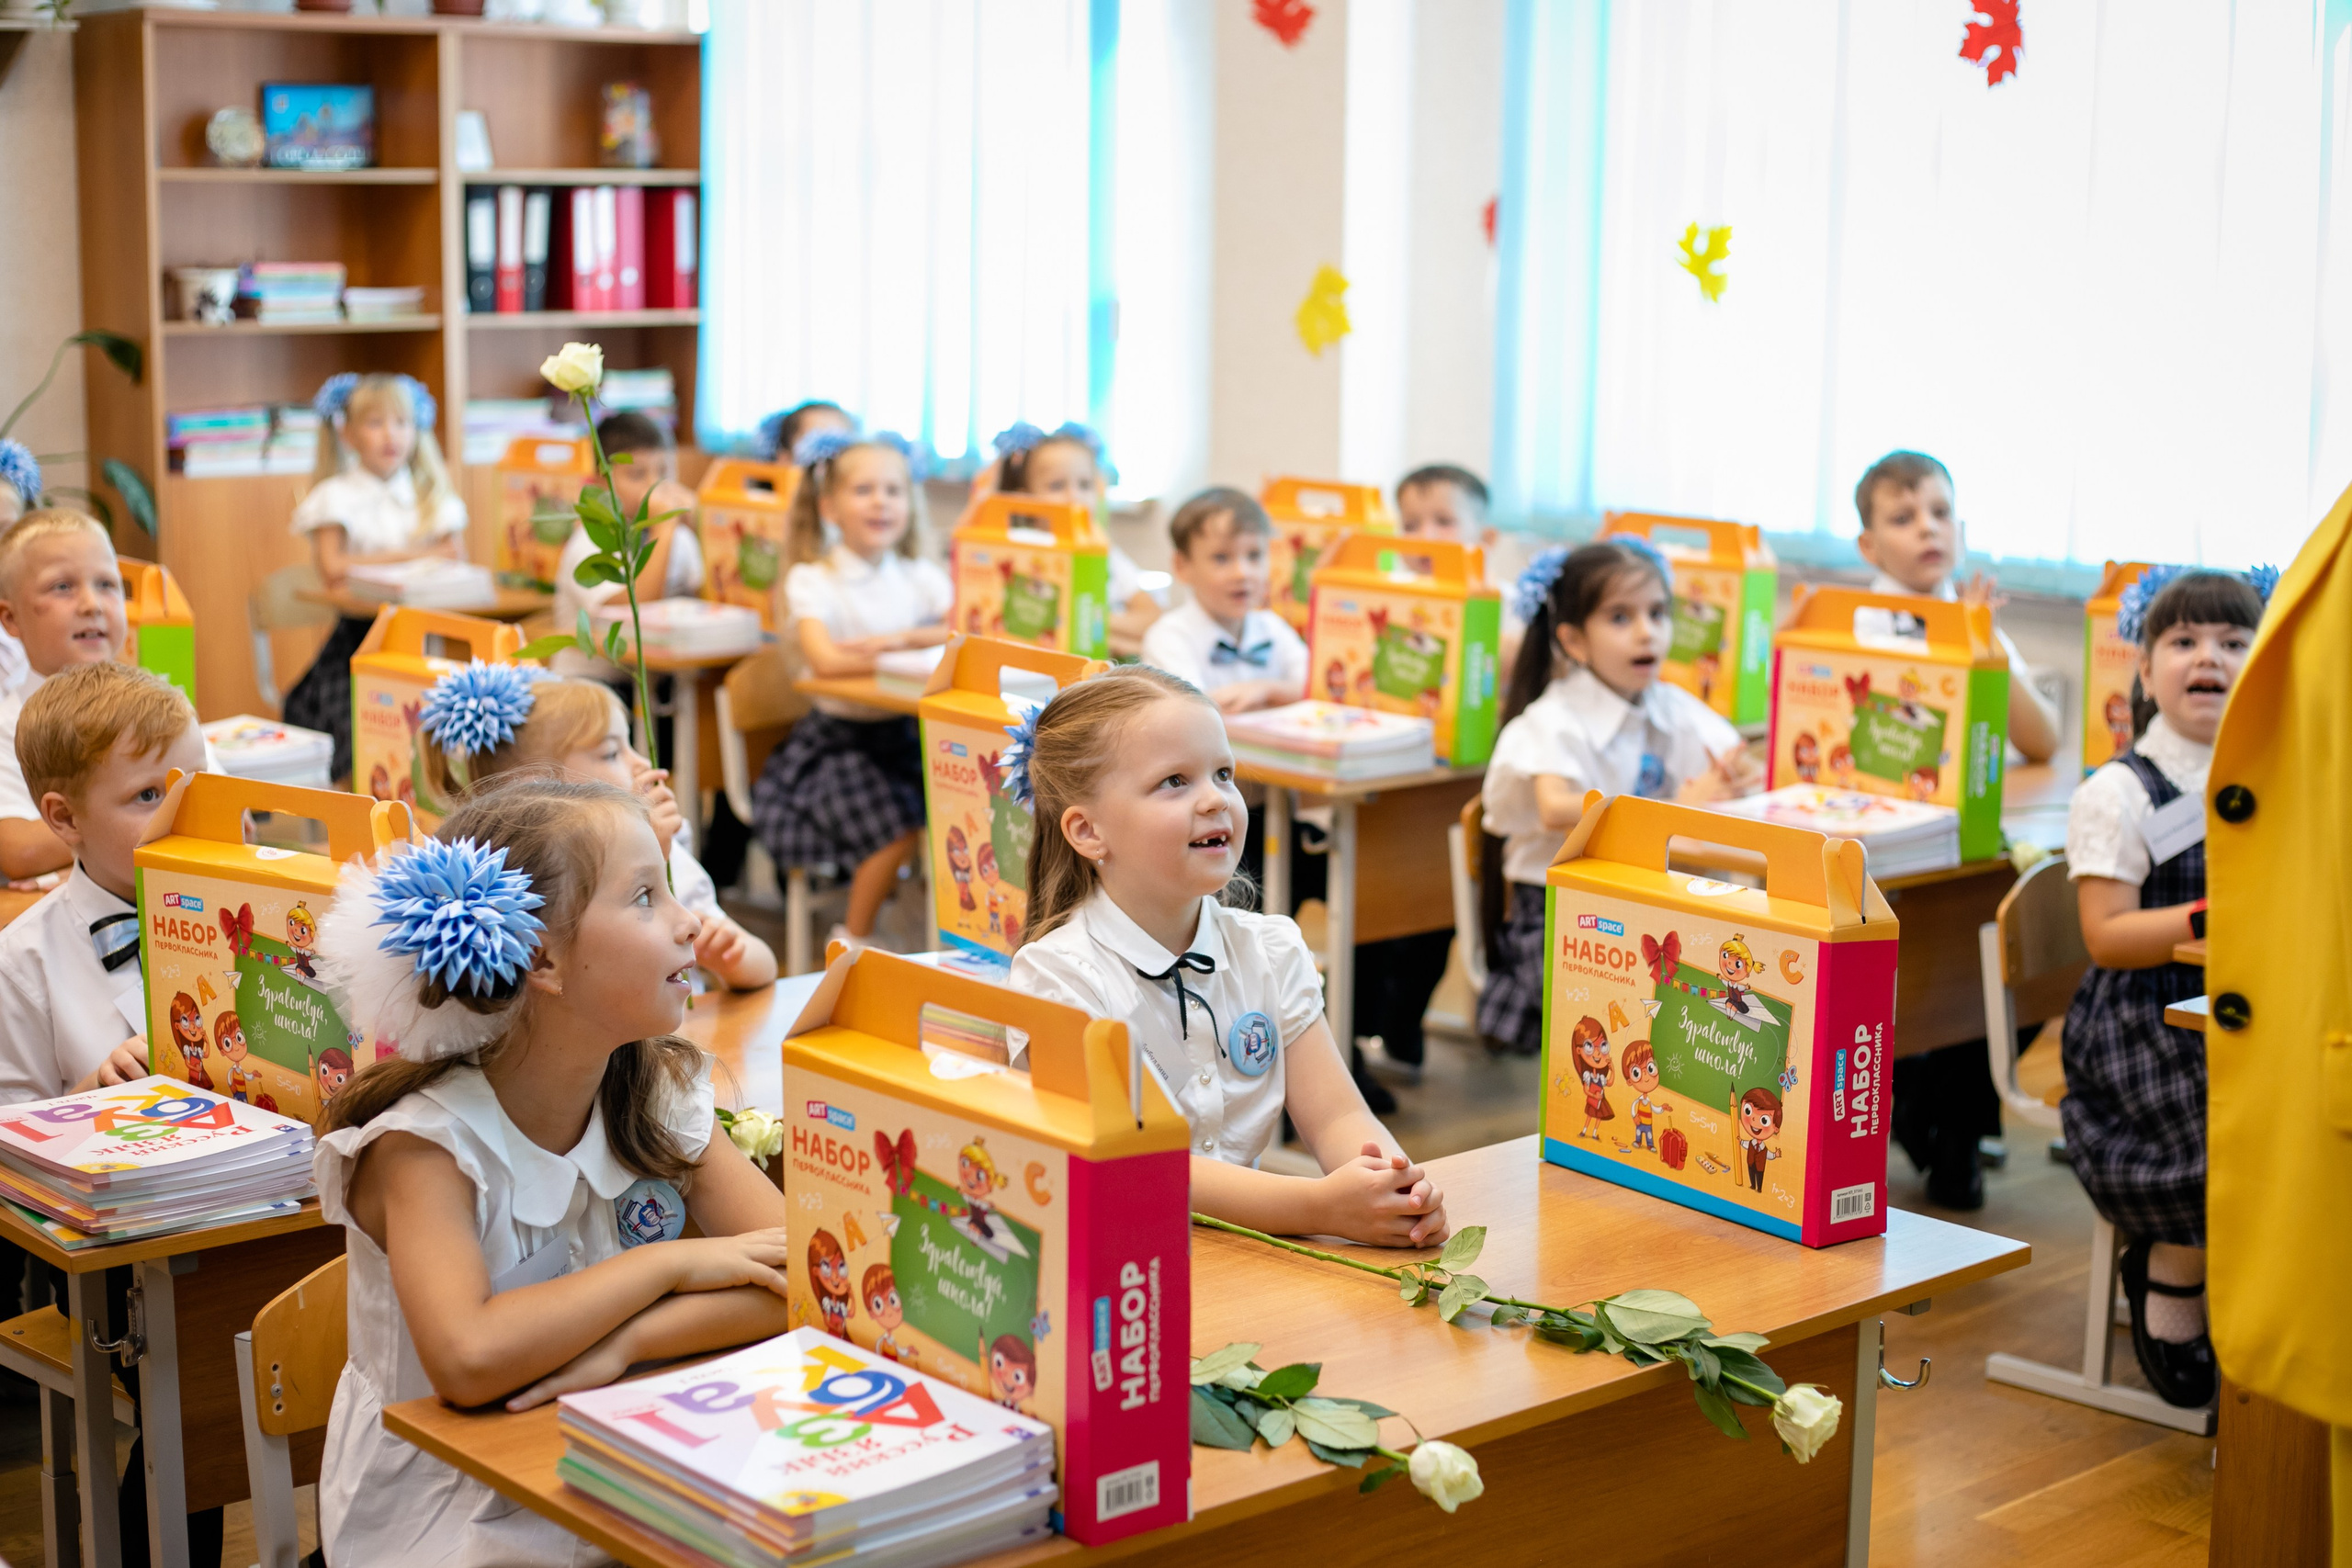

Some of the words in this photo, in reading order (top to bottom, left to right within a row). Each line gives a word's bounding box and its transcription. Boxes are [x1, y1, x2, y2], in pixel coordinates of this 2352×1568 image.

[932, 758, 978, 785] НАБОР
[165, 894, 179, 906] ART
[181, 897, 202, 909] space
[153, 914, 217, 946] НАБОР
[1579, 917, 1596, 927] ART
[1598, 920, 1623, 933] space
[154, 940, 219, 961] ПЕРВОКЛАССНИКА
[1563, 935, 1637, 972] НАБОР
[1563, 961, 1636, 987] ПЕРВОКЛАССНИКА
[274, 1012, 318, 1042] школа!
[1694, 1045, 1746, 1079] школа!
[1837, 1053, 1845, 1089] space
[1850, 1024, 1871, 1139] НАБОР
[1871, 1022, 1883, 1135] ПЕРВОКЛАССНИКА
[88, 1134, 182, 1156] язык
[130, 1124, 258, 1156] Русский
[793, 1124, 870, 1177] НАБОР
[793, 1158, 870, 1195] ПЕРВОКЛАССНИКА
[1120, 1261, 1147, 1411] НАБОР
